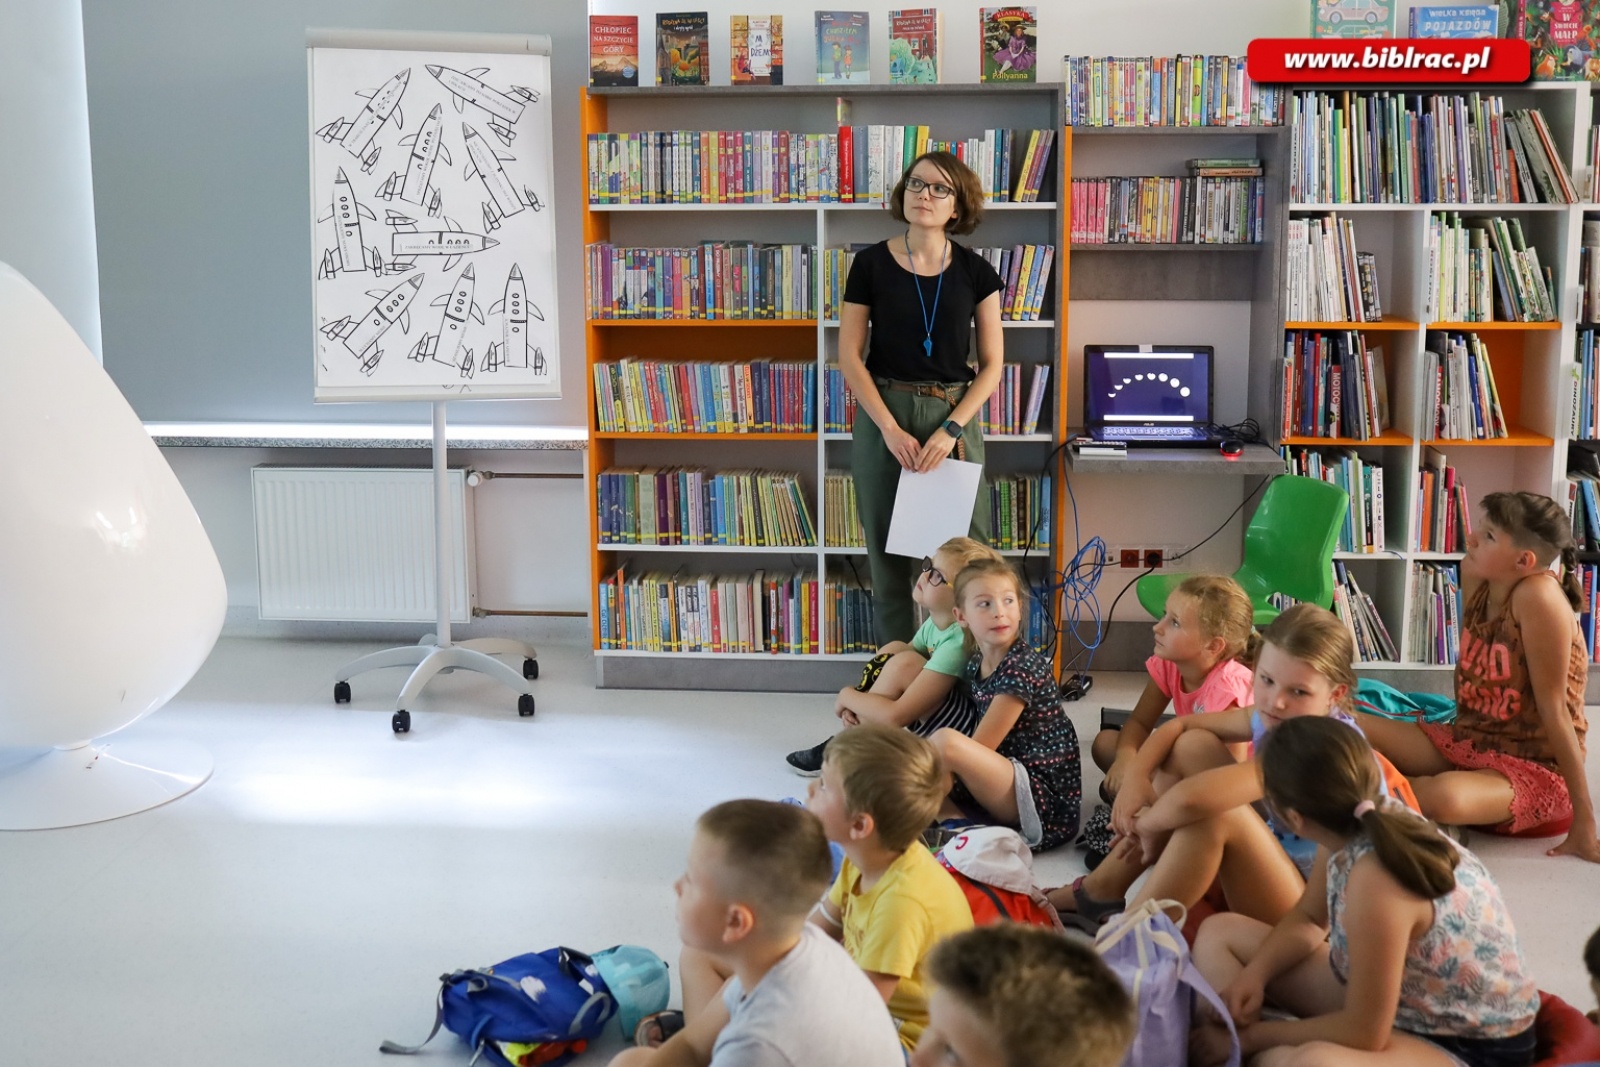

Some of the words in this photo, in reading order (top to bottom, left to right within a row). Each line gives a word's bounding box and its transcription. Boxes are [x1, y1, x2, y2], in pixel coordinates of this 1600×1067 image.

[996, 10, 1025, 18] KLASYKA
[1562, 13, 1572, 22] W
[1424, 17, 1491, 32] POJAZDÓW
[594, 26, 632, 34] CHŁOPIEC
[992, 72, 1028, 81] Pollyanna
[1570, 380, 1578, 436] DINOZAURY
